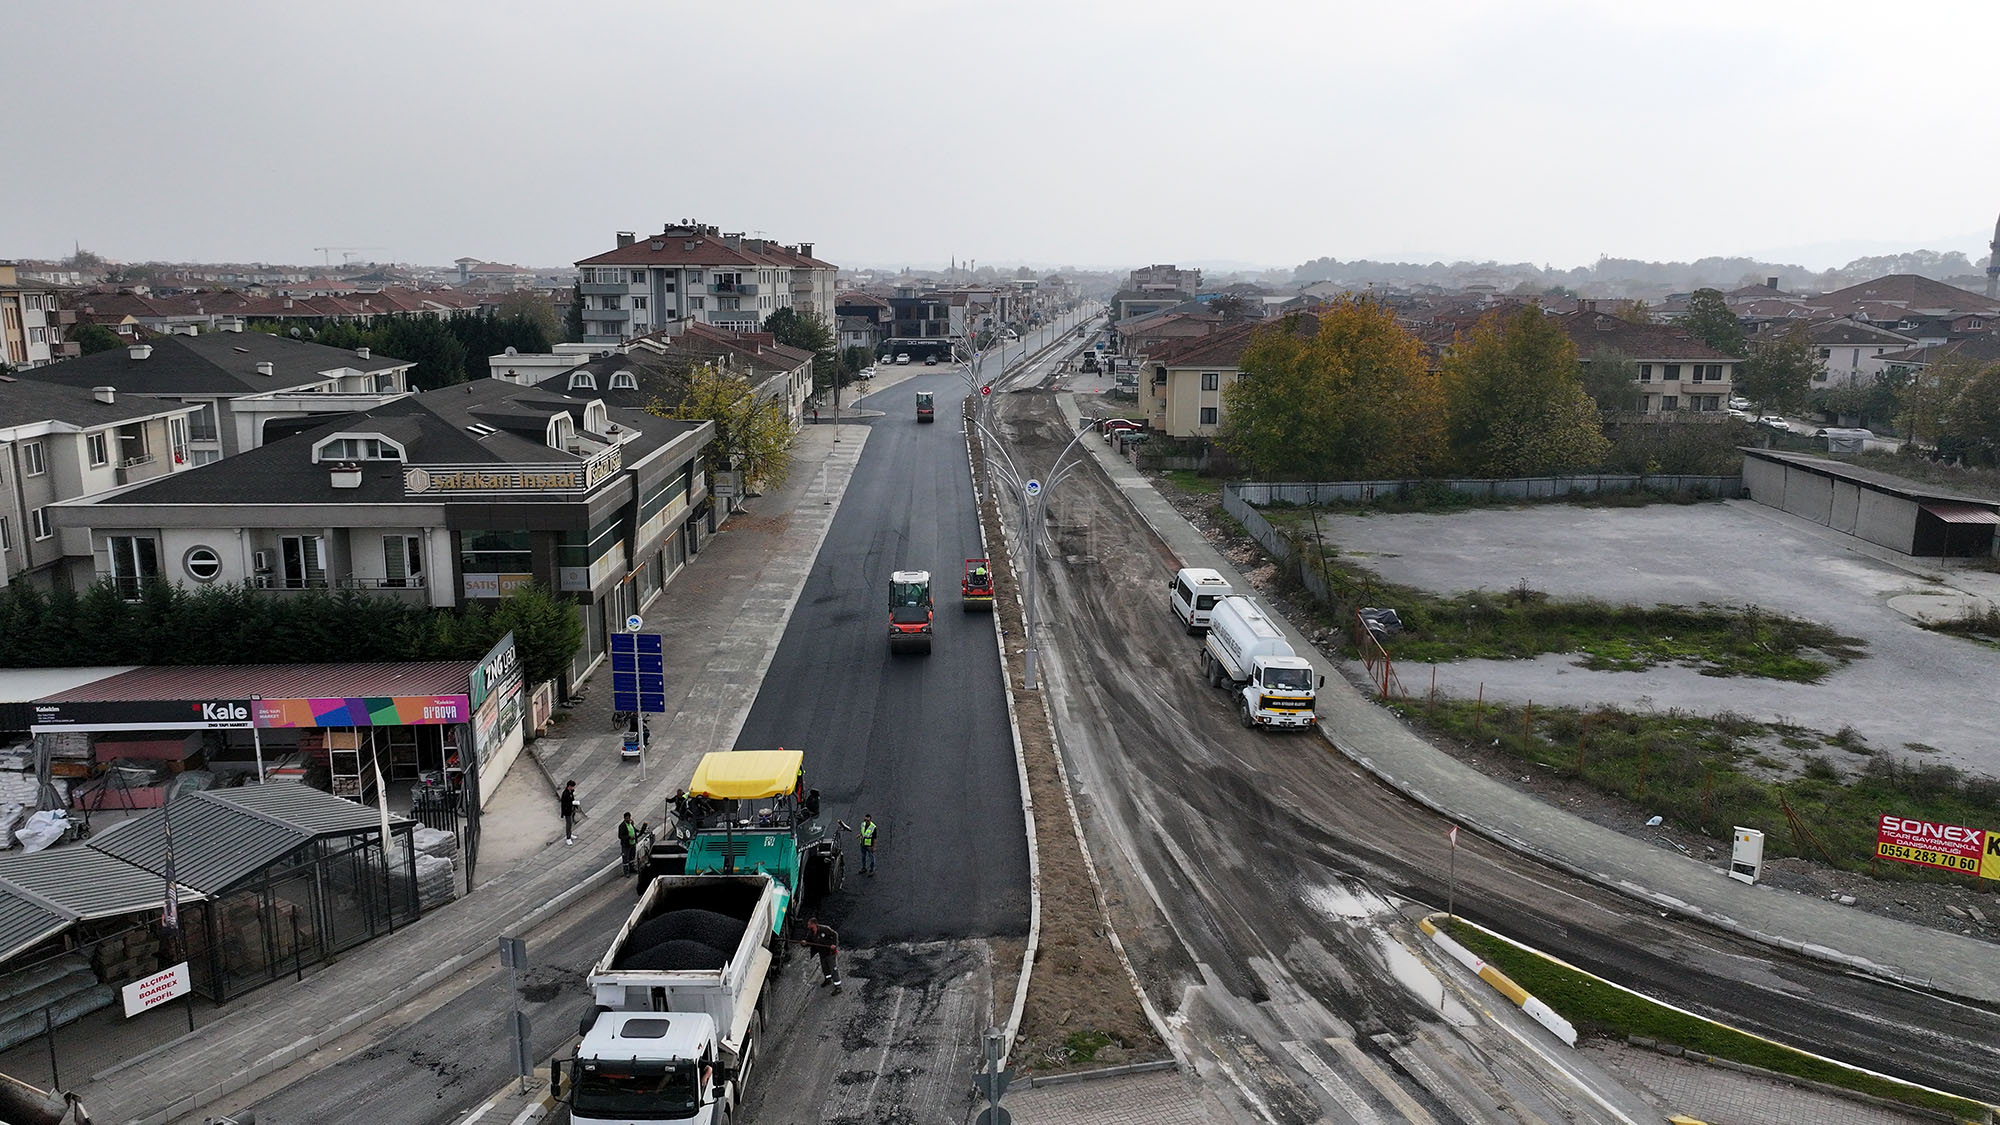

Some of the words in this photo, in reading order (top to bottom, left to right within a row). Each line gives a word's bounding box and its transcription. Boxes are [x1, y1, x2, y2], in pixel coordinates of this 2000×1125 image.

[519, 471, 577, 492] inşaat
[485, 653, 503, 690] ZNG
[202, 702, 248, 720] Kale
[1882, 816, 1981, 846] SONEX
[1882, 829, 1911, 840] TİCARİ
[1911, 835, 1980, 852] GAYRİMENKUL
[1880, 843, 1910, 859] 0554
[1913, 849, 1937, 864] 283
[1941, 854, 1956, 867] 70
[1960, 859, 1975, 871] 60
[138, 979, 178, 1000] BOARDEX
[139, 971, 175, 990] ALÇIPAN
[144, 990, 175, 1007] PROFİL
